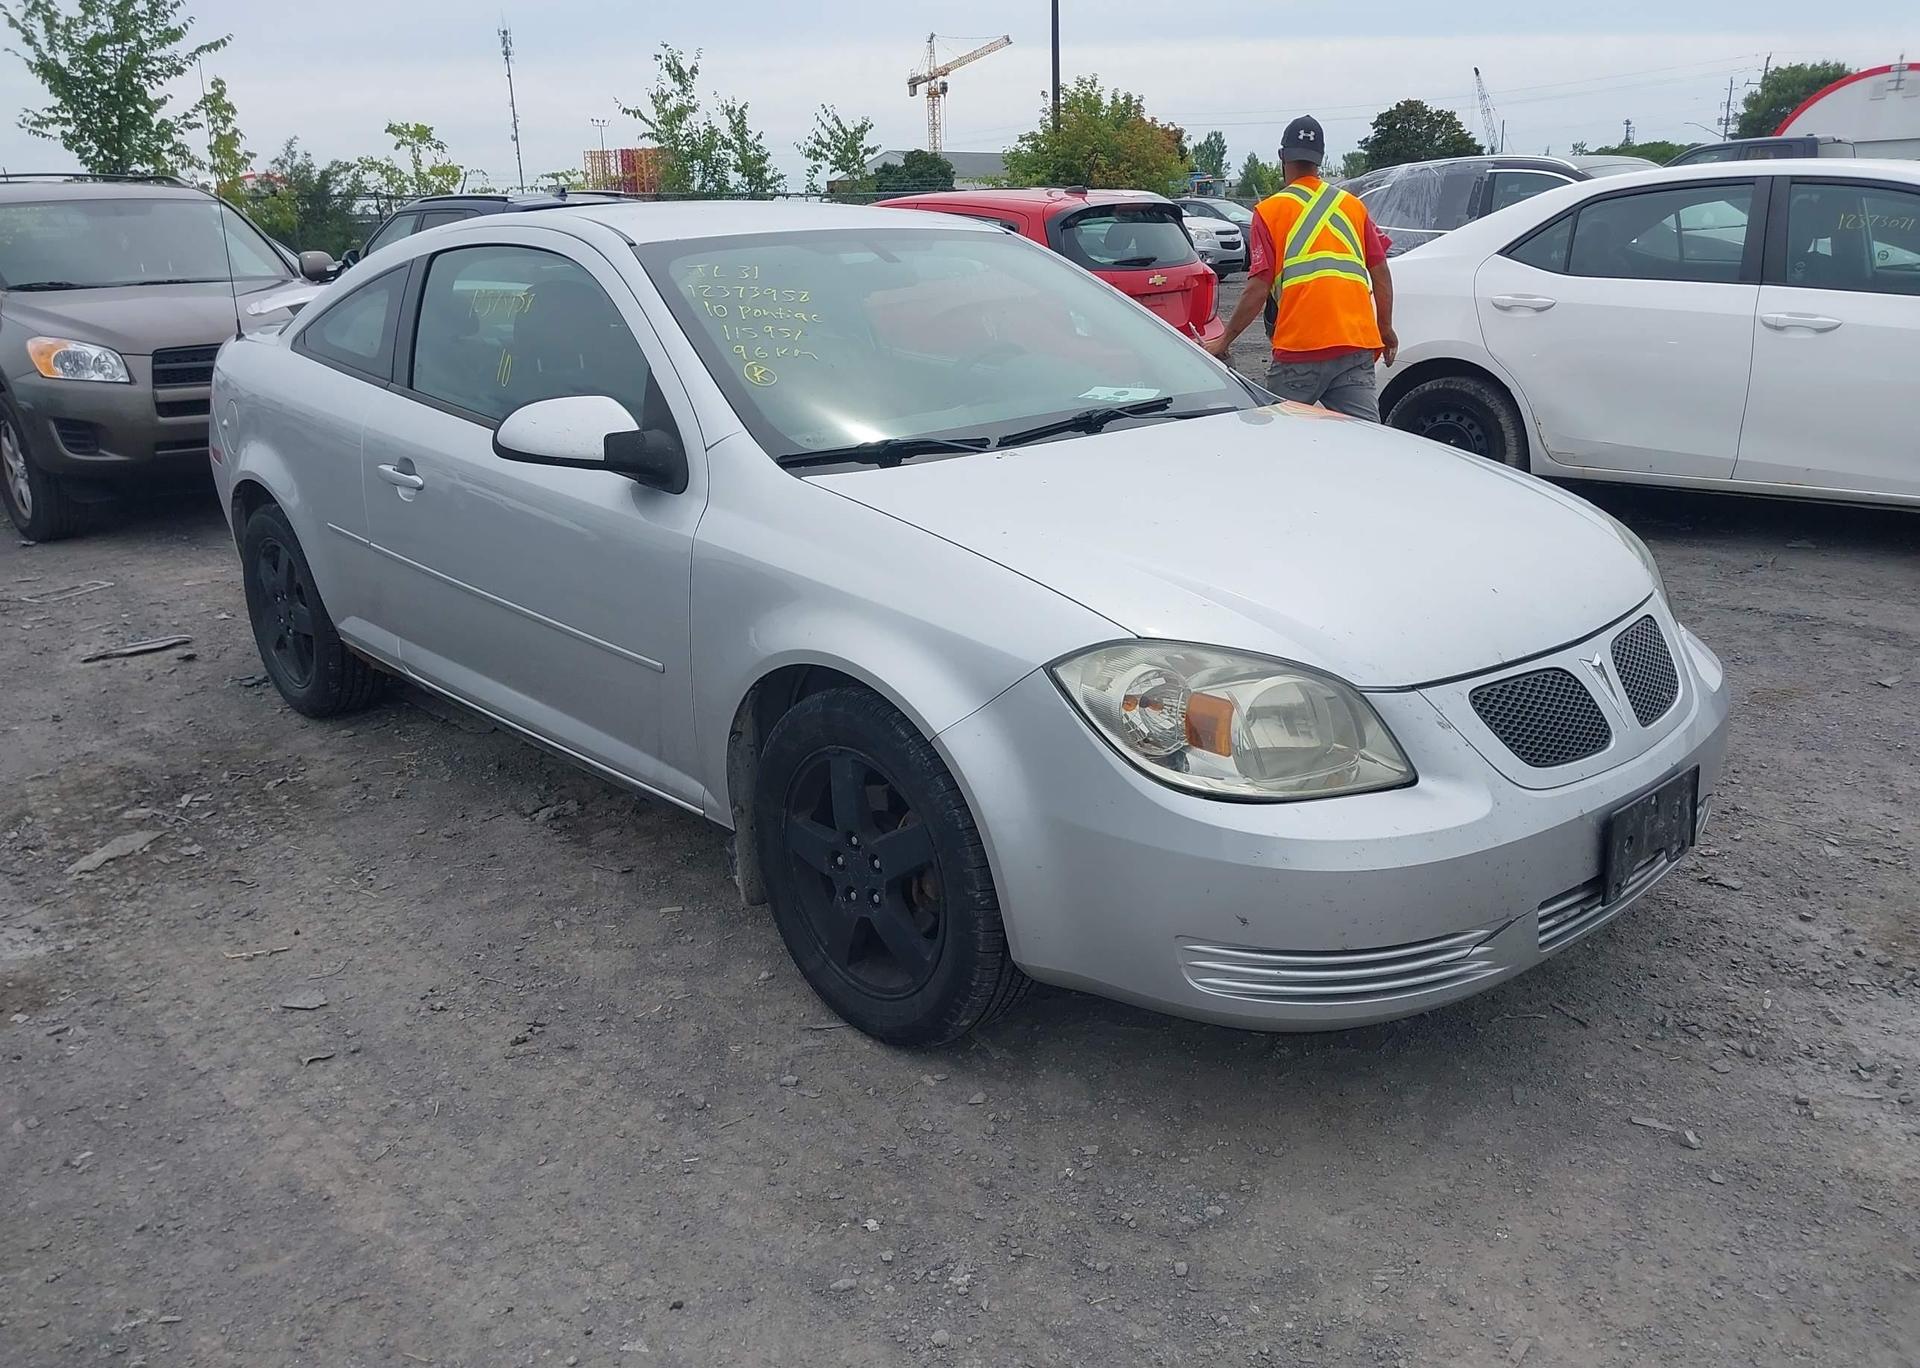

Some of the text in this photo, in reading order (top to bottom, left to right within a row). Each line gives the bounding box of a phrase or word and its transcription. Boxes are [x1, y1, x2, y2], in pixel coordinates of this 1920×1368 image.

[736, 264, 759, 281] 31
[704, 301, 728, 317] 10
[496, 347, 512, 388] 10
